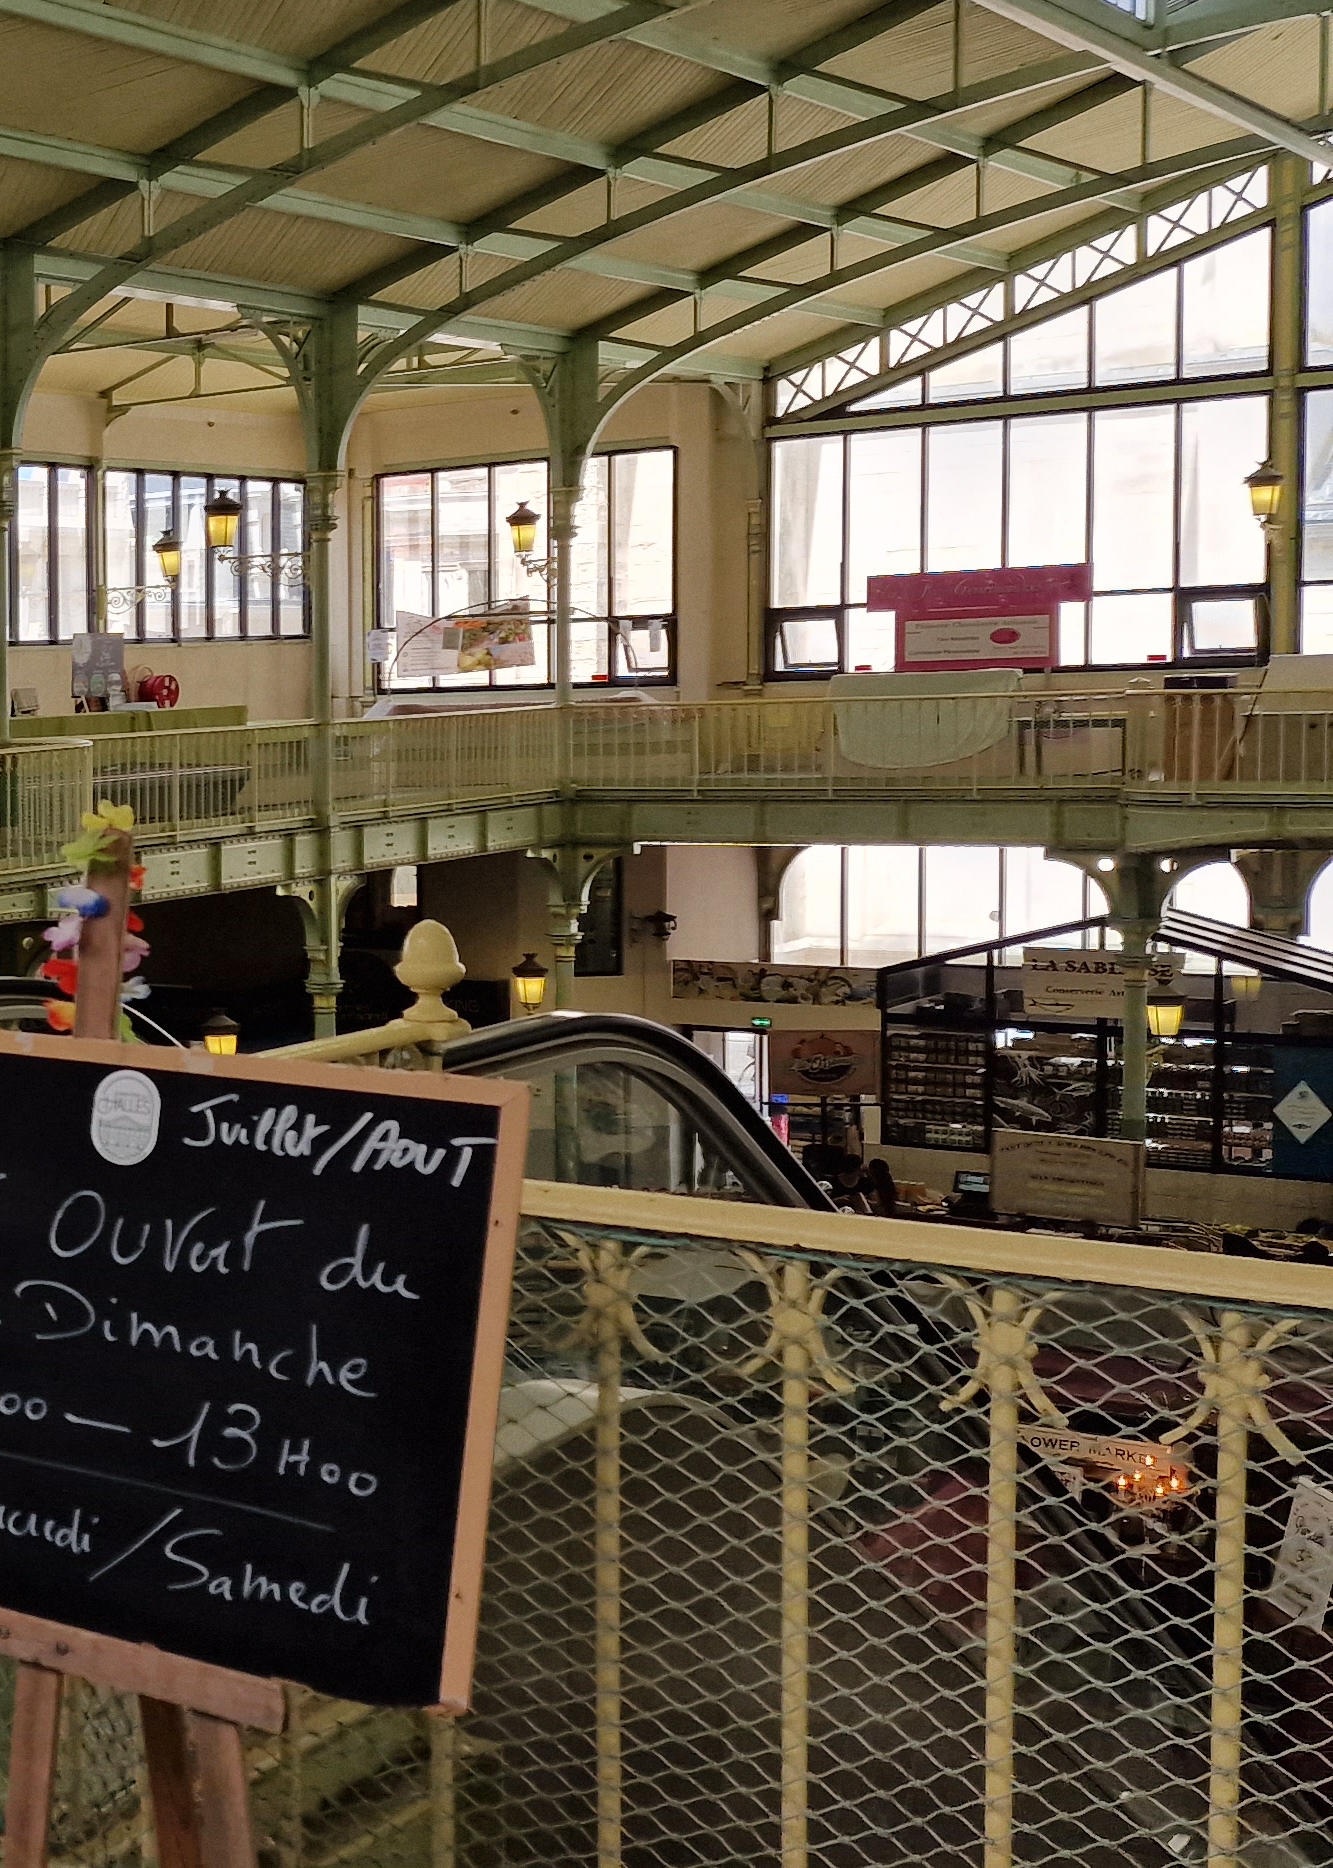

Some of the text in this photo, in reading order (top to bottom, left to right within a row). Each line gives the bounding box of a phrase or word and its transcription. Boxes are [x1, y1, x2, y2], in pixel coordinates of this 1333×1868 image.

[1031, 958, 1175, 978] LA SABLSE
[319, 1223, 421, 1301] du
[13, 1279, 379, 1398] Dimanche
